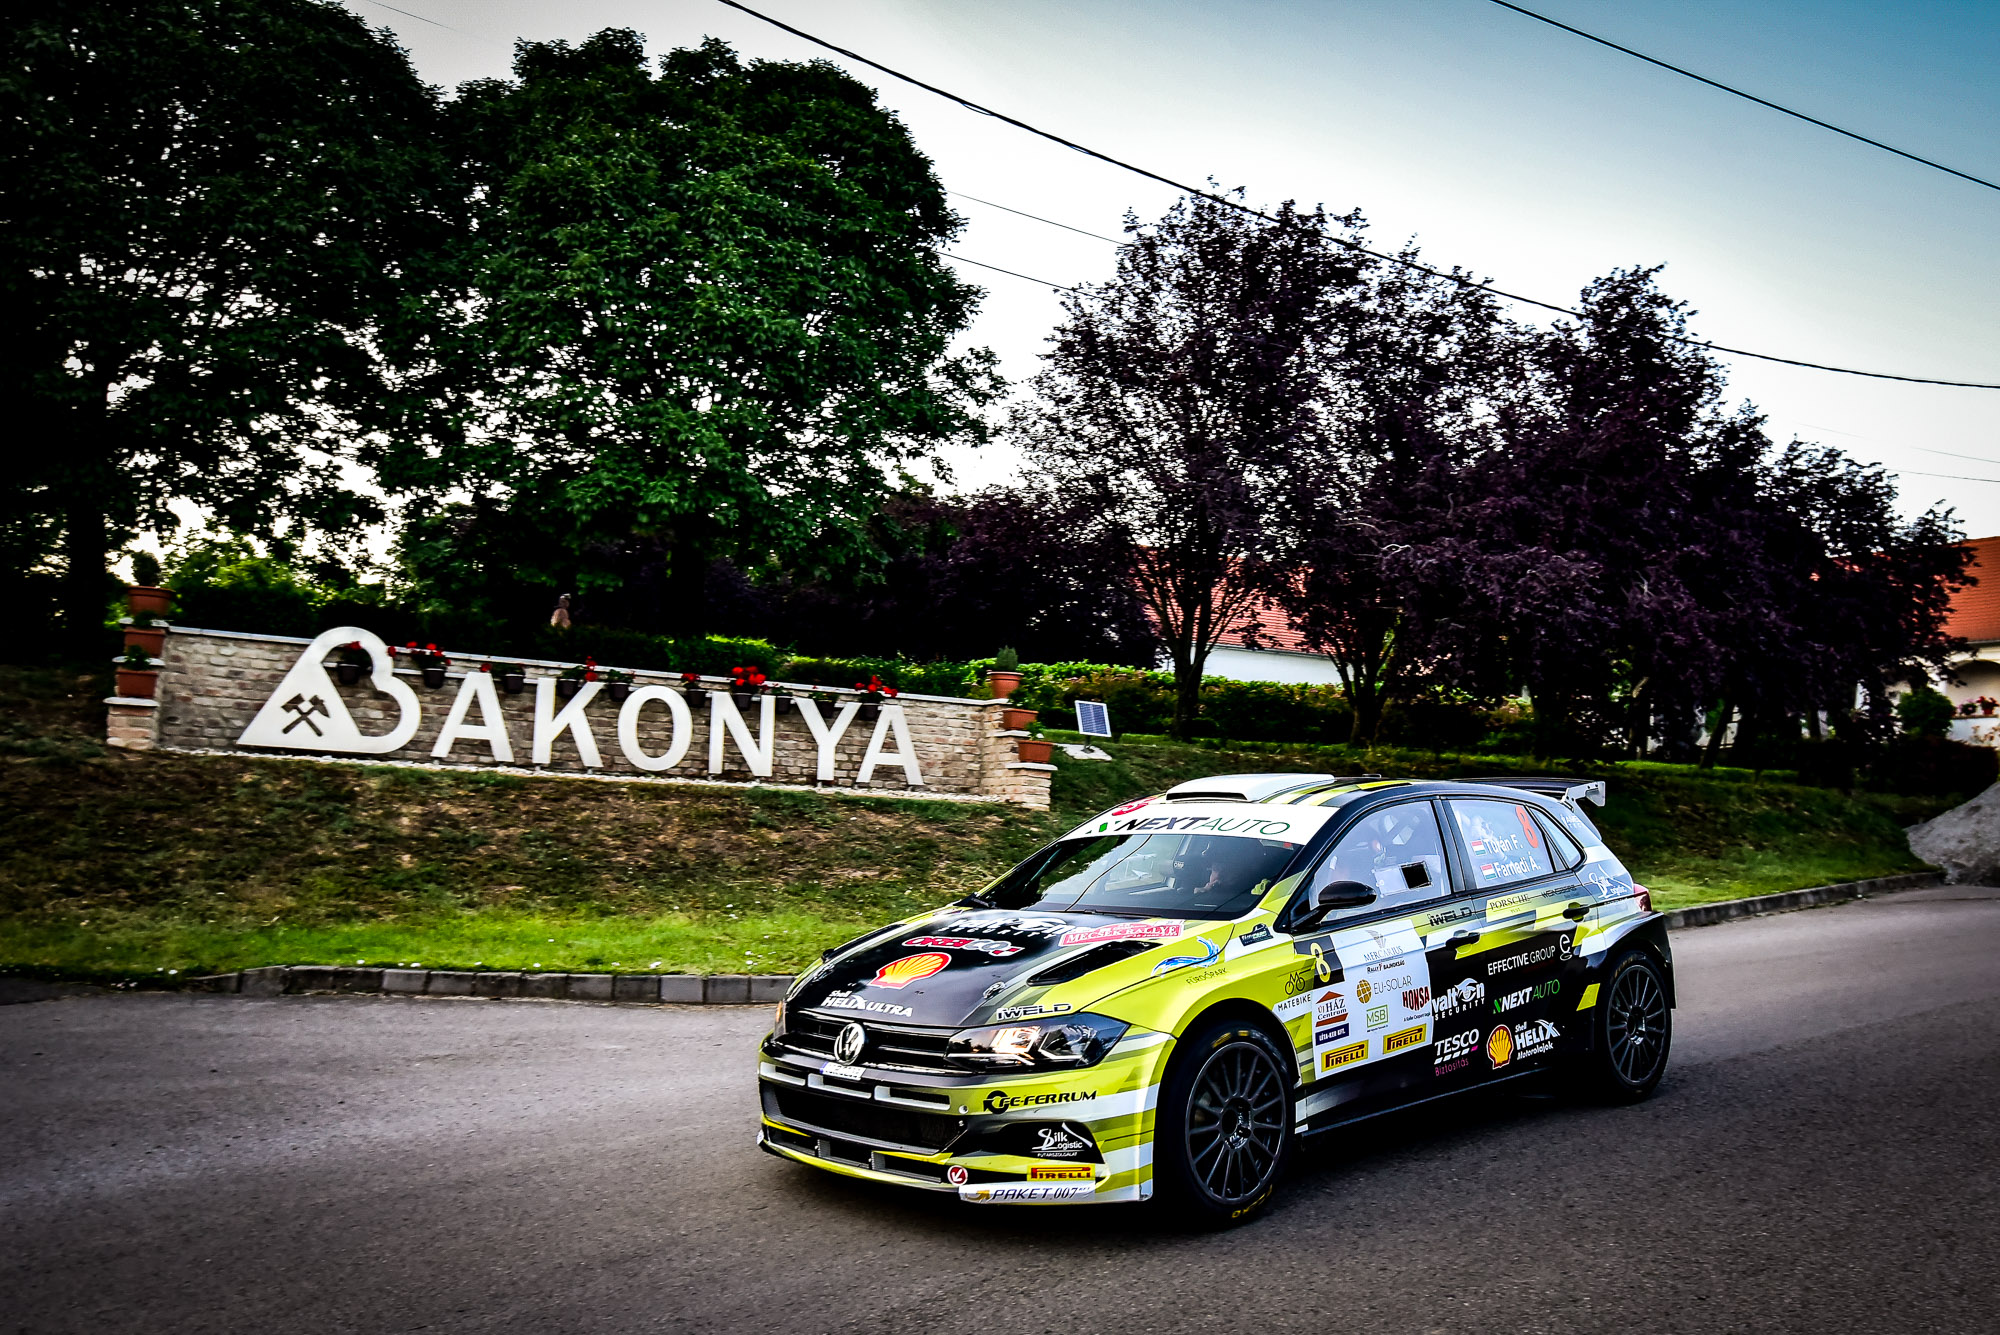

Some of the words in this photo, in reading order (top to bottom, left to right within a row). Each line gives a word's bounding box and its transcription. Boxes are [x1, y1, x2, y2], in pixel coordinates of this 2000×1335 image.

[236, 625, 925, 789] BAKONYA
[1515, 805, 1539, 849] 8
[1483, 834, 1513, 854] Turán
[1490, 893, 1530, 910] PORSCHE
[1066, 928, 1122, 944] MECSEK
[1124, 924, 1178, 936] RALLYE
[1310, 942, 1331, 983] 8
[1363, 946, 1404, 962] MERCARIUS
[1487, 952, 1529, 976] EFFECTIVE
[1529, 945, 1556, 964] GROUP
[1373, 975, 1412, 995] EU-SOLAR
[1277, 994, 1311, 1012] MATEBIKE
[1402, 986, 1430, 1011] HONSA
[1317, 1008, 1347, 1021] Centrum
[1367, 1009, 1386, 1024] MSB
[1435, 998, 1485, 1021] SECURITY
[1382, 1027, 1424, 1051] PIRELLI
[1434, 1028, 1480, 1057] TESCO
[1514, 1019, 1561, 1051] HELIX
[1325, 1043, 1366, 1069] PIRELLI
[1434, 1057, 1470, 1077] Biztosítás
[1030, 1166, 1092, 1179] PIRELLI
[992, 1188, 1052, 1200] PAKET
